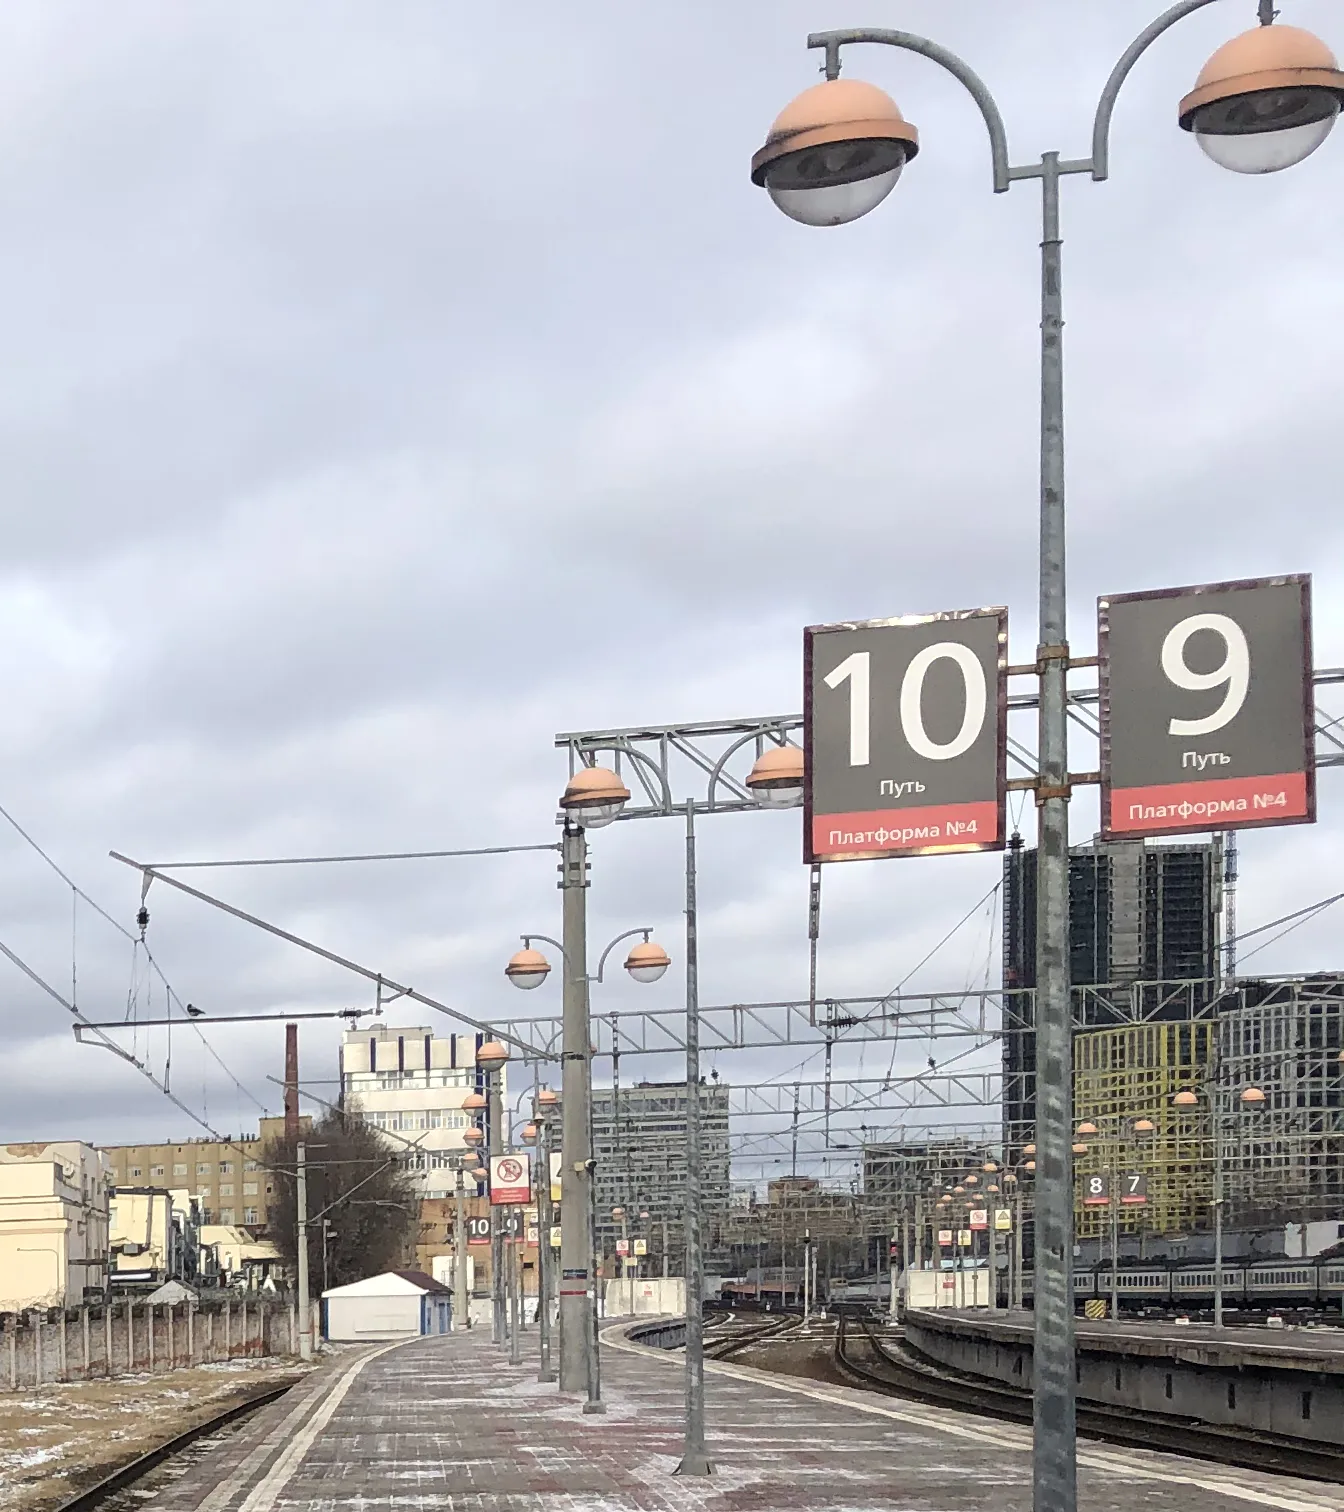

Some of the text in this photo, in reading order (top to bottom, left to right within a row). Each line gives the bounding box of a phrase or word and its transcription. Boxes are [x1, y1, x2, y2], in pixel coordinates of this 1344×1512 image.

[1160, 613, 1250, 736] 9
[823, 641, 987, 766] 10
[1182, 752, 1231, 770] Путь
[880, 780, 926, 798] Путь
[1129, 792, 1287, 819] Платформа №4
[829, 820, 978, 845] Платформа №4
[1090, 1177, 1103, 1193] 8
[1128, 1175, 1140, 1192] 7
[469, 1219, 489, 1235] 10
